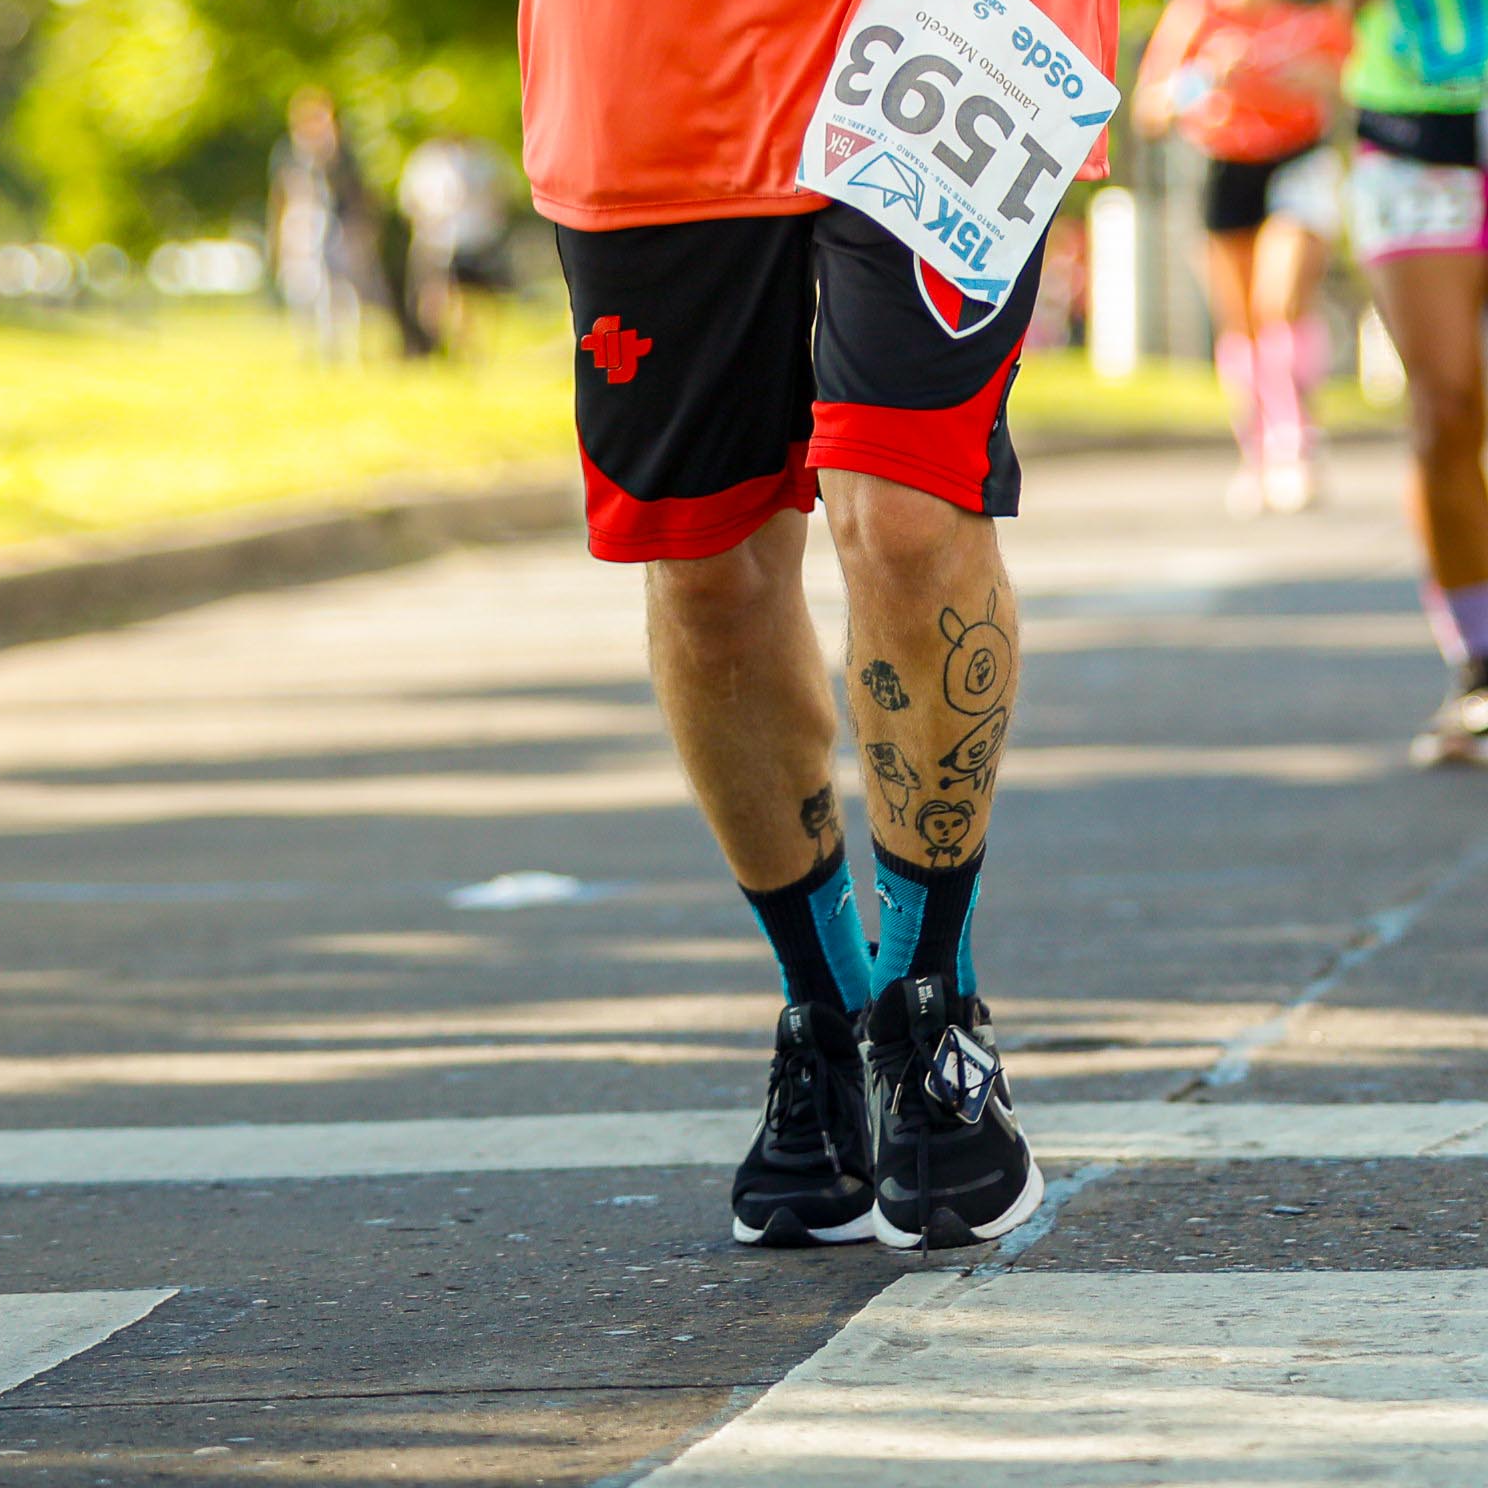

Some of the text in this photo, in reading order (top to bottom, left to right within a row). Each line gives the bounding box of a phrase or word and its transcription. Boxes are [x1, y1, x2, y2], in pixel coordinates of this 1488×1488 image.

[915, 11, 1041, 121] Lamberto Marcelo
[1012, 25, 1083, 99] osde
[826, 132, 856, 158] 15K
[834, 24, 1063, 225] 1593
[896, 144, 929, 173] ROSARIO
[953, 192, 977, 215] NORTE
[977, 214, 1005, 241] PUERTO
[923, 195, 993, 272] 15K
